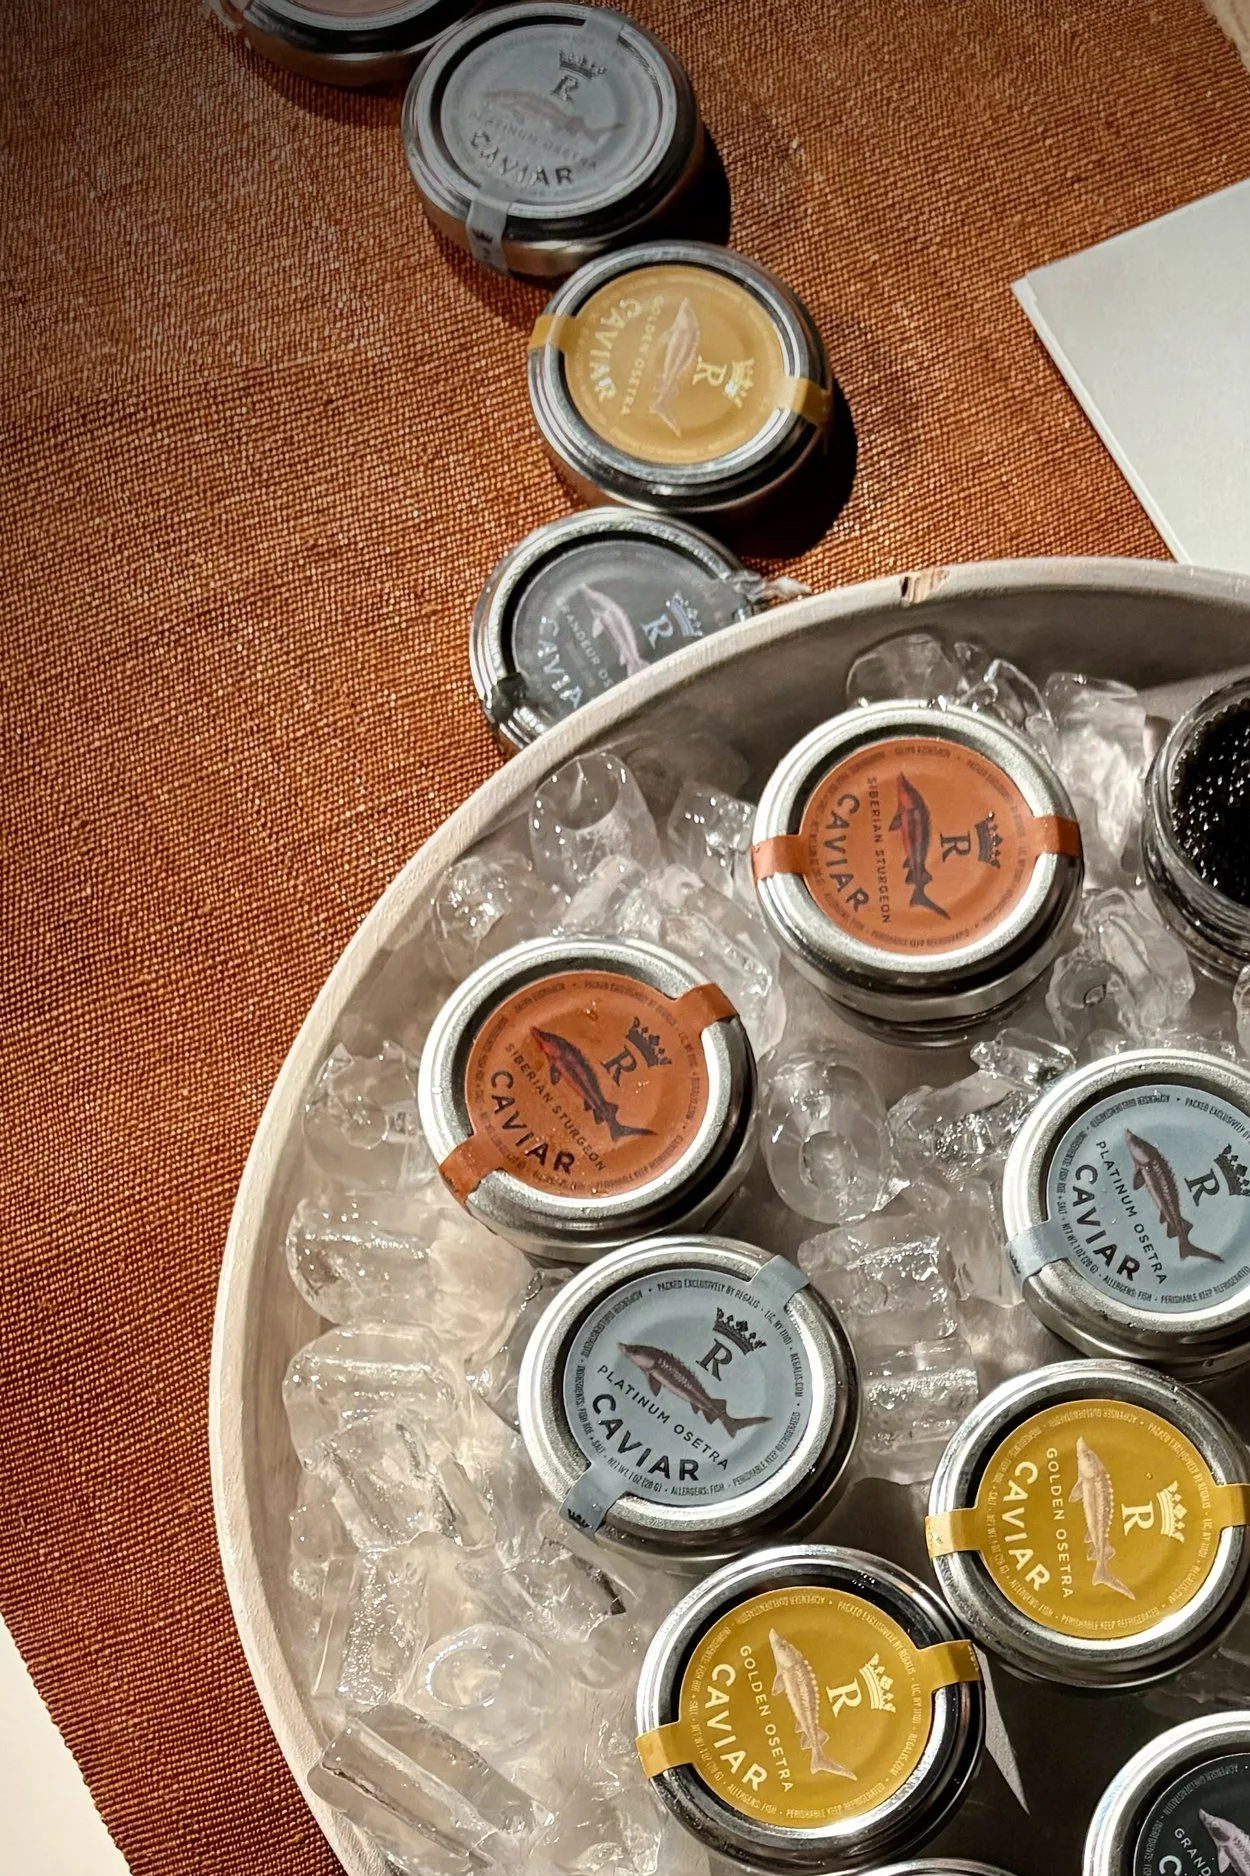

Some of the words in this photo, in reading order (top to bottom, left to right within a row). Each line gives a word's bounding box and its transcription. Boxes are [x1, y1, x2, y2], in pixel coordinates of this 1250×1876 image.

[552, 76, 578, 102] R
[470, 131, 572, 186] CAVIAR
[590, 299, 641, 402] CAVIAR
[640, 296, 664, 353] GOLDEN
[692, 356, 727, 386] R
[538, 616, 582, 708] CAVIA
[641, 613, 673, 649] R
[825, 793, 869, 912] CAVIAR
[867, 778, 883, 844] SIBERIAN
[875, 850, 891, 924] STURGEON
[940, 832, 971, 863] R
[505, 1043, 551, 1104] SIBERIAN
[552, 1105, 606, 1171] STURGEON
[601, 1045, 637, 1086] R
[490, 1070, 576, 1174] CAVIAR
[1072, 1164, 1140, 1281] CAVIAR
[1096, 1141, 1138, 1217] PLATINUM
[1134, 1223, 1167, 1285] OSETRA
[1185, 1168, 1220, 1207] R
[696, 1339, 732, 1381] R
[593, 1393, 699, 1481] CAVIAR
[598, 1365, 670, 1425] PLATINUM
[674, 1424, 729, 1470] OSETRA
[1002, 1461, 1050, 1591] CAVIAR
[1047, 1447, 1065, 1520] GOLDEN
[1056, 1528, 1073, 1598] OSETRA
[1121, 1503, 1154, 1535] R
[704, 1663, 768, 1791] CAVIAR
[739, 1645, 771, 1716] GOLDEN
[766, 1723, 794, 1792] OSETRA
[827, 1677, 861, 1718] R
